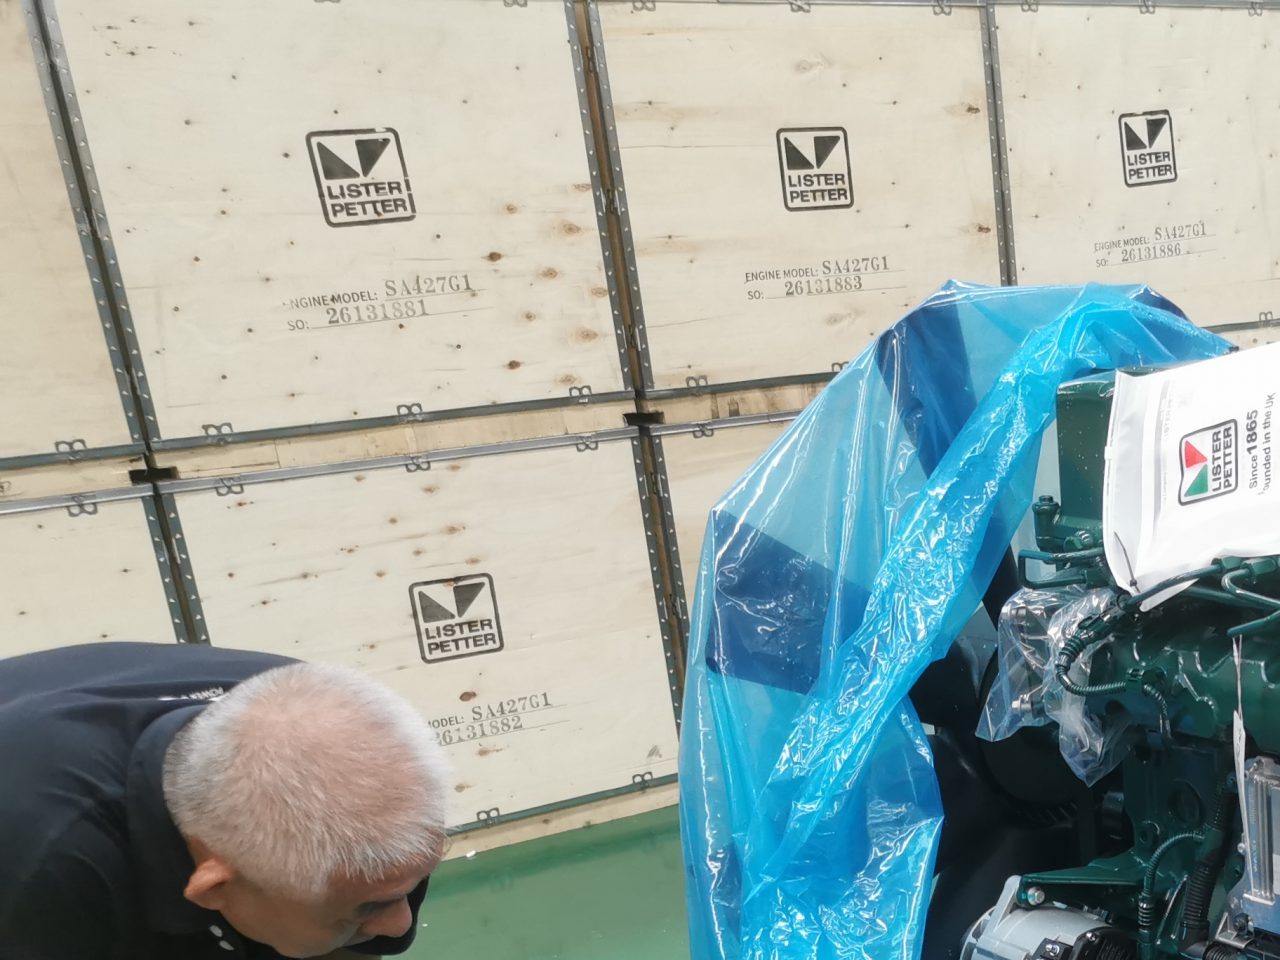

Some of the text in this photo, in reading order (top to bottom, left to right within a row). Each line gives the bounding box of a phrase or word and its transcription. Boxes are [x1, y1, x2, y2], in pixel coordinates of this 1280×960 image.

[1127, 151, 1170, 166] LISTER
[788, 174, 845, 187] LISTER
[1128, 164, 1172, 179] PETTER
[327, 181, 402, 200] LISTER
[790, 189, 848, 203] PETTER
[330, 198, 407, 217] PETTER
[1094, 222, 1207, 252] ENGINE MODEL: SA427G1
[1096, 243, 1181, 268] SO: 26131886
[745, 256, 890, 283] ENGINE MODEL: SA427G1
[283, 274, 474, 309] NGINE MODEL: SA427G1
[747, 276, 863, 300] SO: 26131883
[287, 299, 429, 331] SO: 26131881
[1264, 392, 1276, 408] UK
[1262, 410, 1272, 430] the
[1246, 409, 1258, 489] Since 1865
[1263, 432, 1271, 445] in
[1211, 430, 1222, 492] LISTER
[1223, 426, 1233, 489] PETTER
[425, 618, 493, 640] LISTER
[427, 632, 496, 655] PETTER
[428, 692, 553, 729] ODEL: SA427G1
